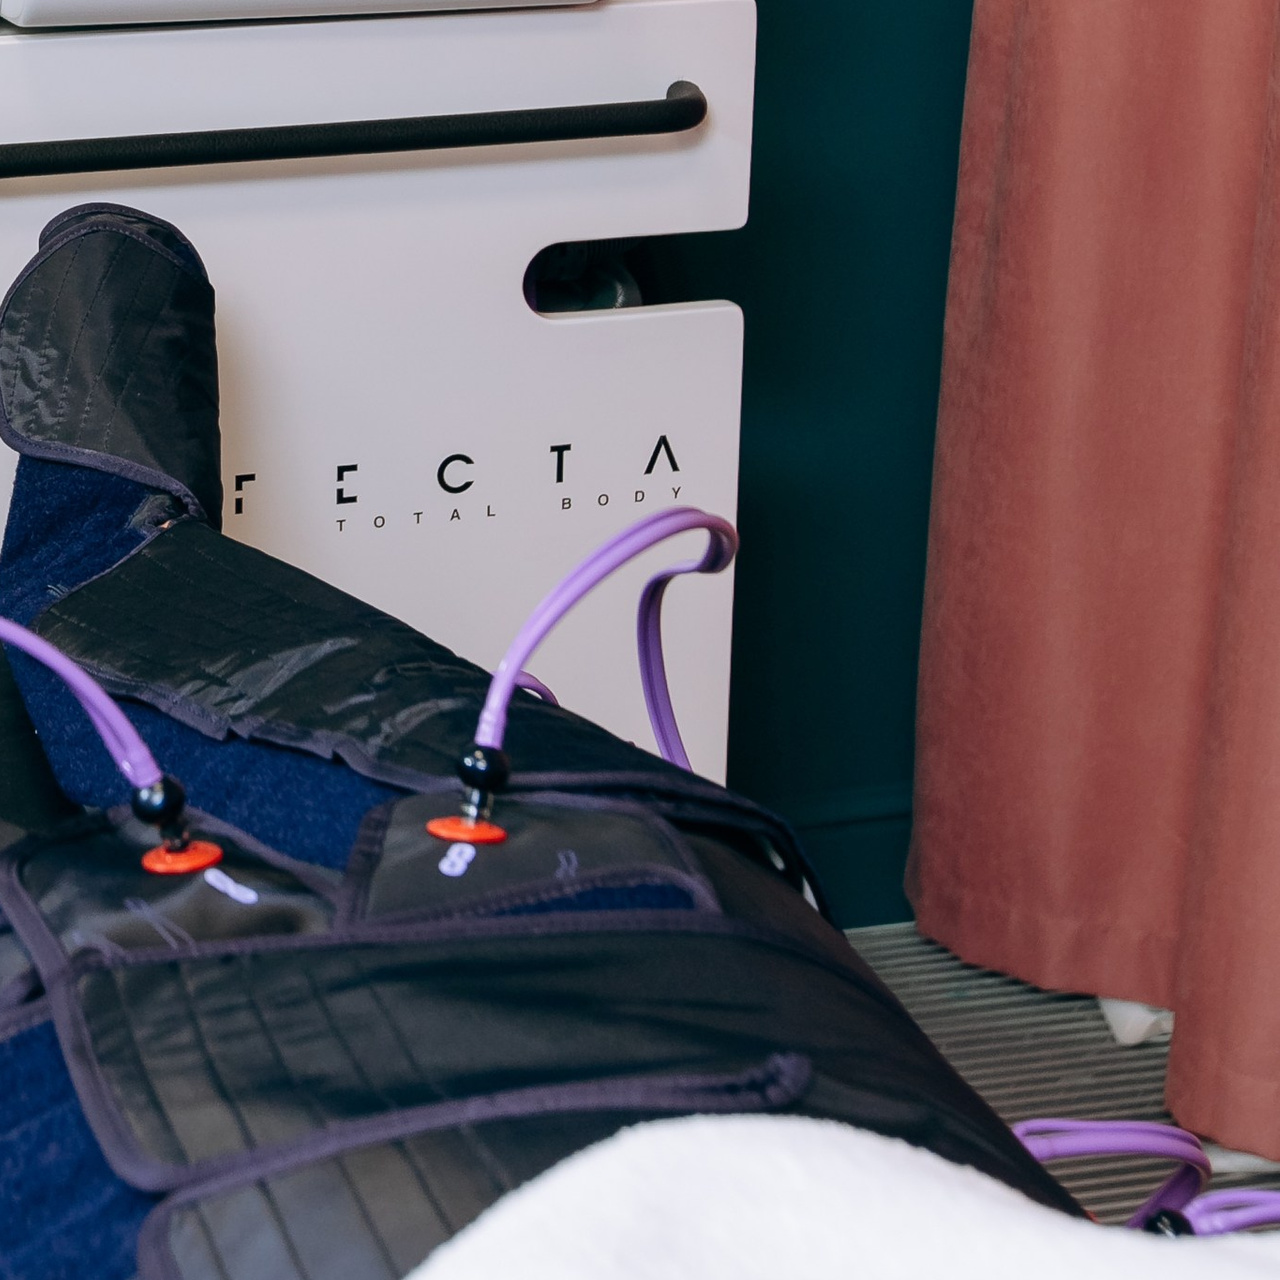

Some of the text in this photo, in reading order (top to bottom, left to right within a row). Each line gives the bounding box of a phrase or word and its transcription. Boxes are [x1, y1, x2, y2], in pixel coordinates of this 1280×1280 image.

[336, 486, 682, 532] TOTAL BODY
[437, 841, 477, 878] 8
